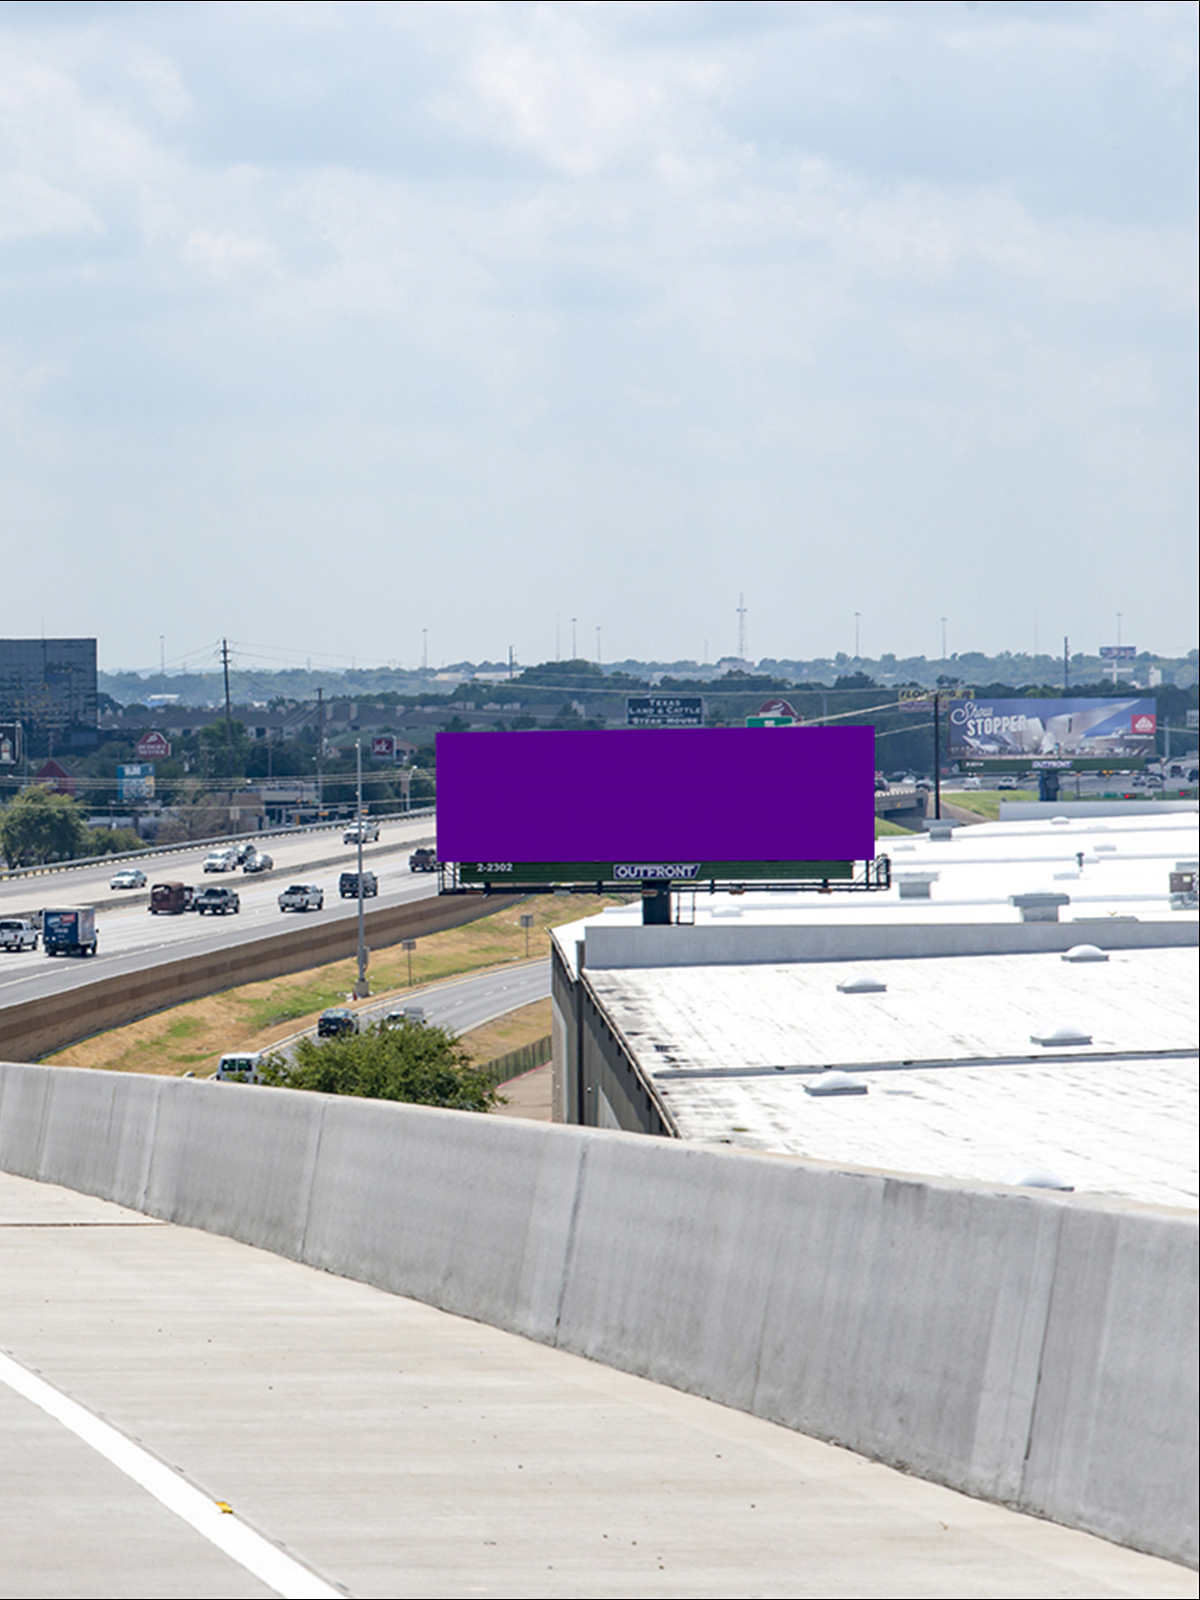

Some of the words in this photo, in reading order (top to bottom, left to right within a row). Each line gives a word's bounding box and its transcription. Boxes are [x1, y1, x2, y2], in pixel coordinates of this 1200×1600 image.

[628, 707, 655, 715] LAND
[666, 706, 701, 715] CATTLE
[632, 717, 662, 725] STEAK
[667, 717, 698, 725] HOUSE
[966, 715, 1027, 737] STOPPER
[476, 863, 513, 872] 2-2302
[616, 866, 695, 878] OUTFRONT
